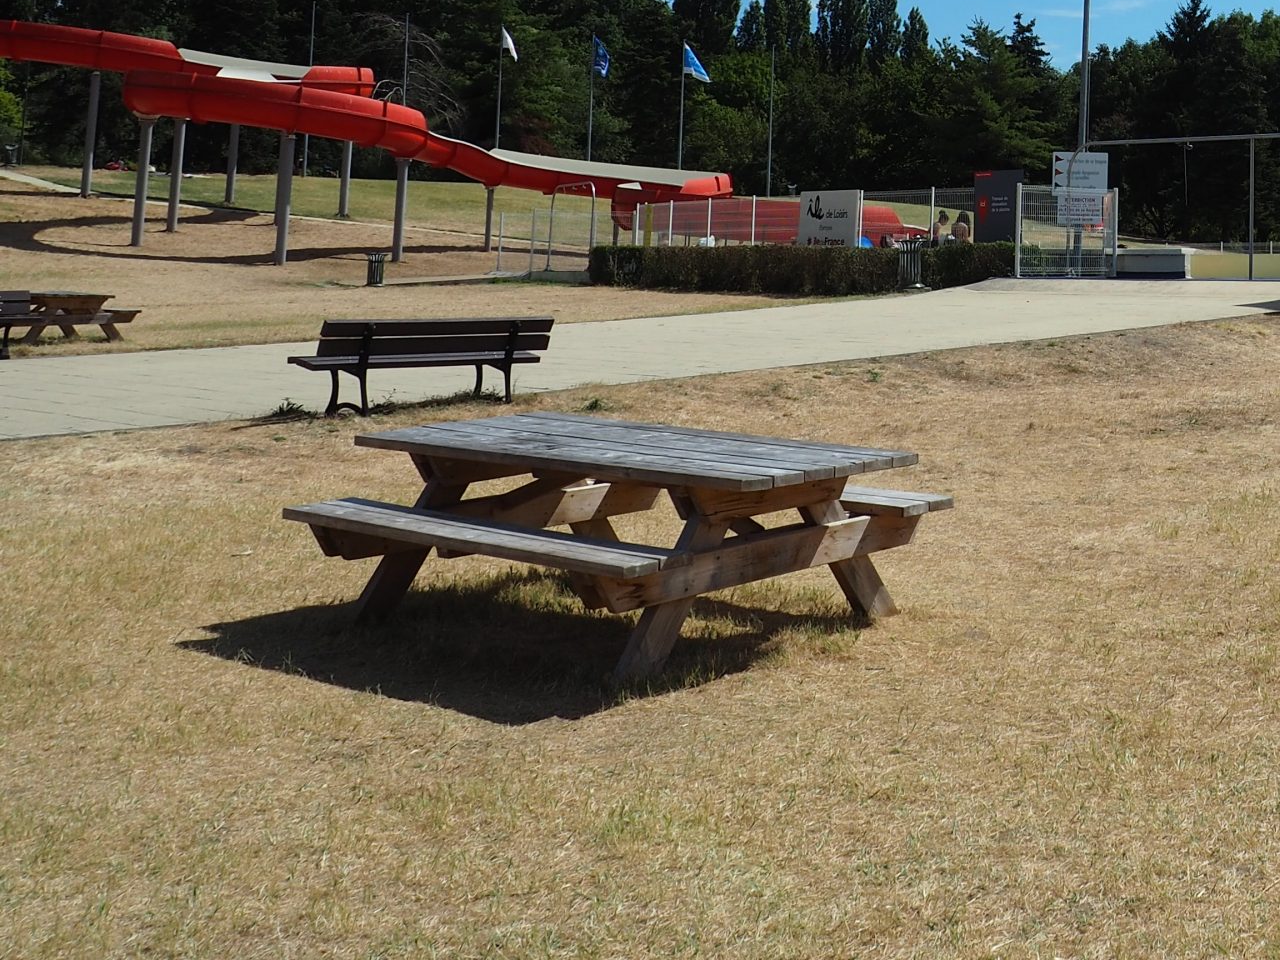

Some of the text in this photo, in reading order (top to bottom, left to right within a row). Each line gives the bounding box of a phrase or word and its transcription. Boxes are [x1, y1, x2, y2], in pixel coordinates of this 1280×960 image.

[807, 195, 849, 220] île de Loisirs
